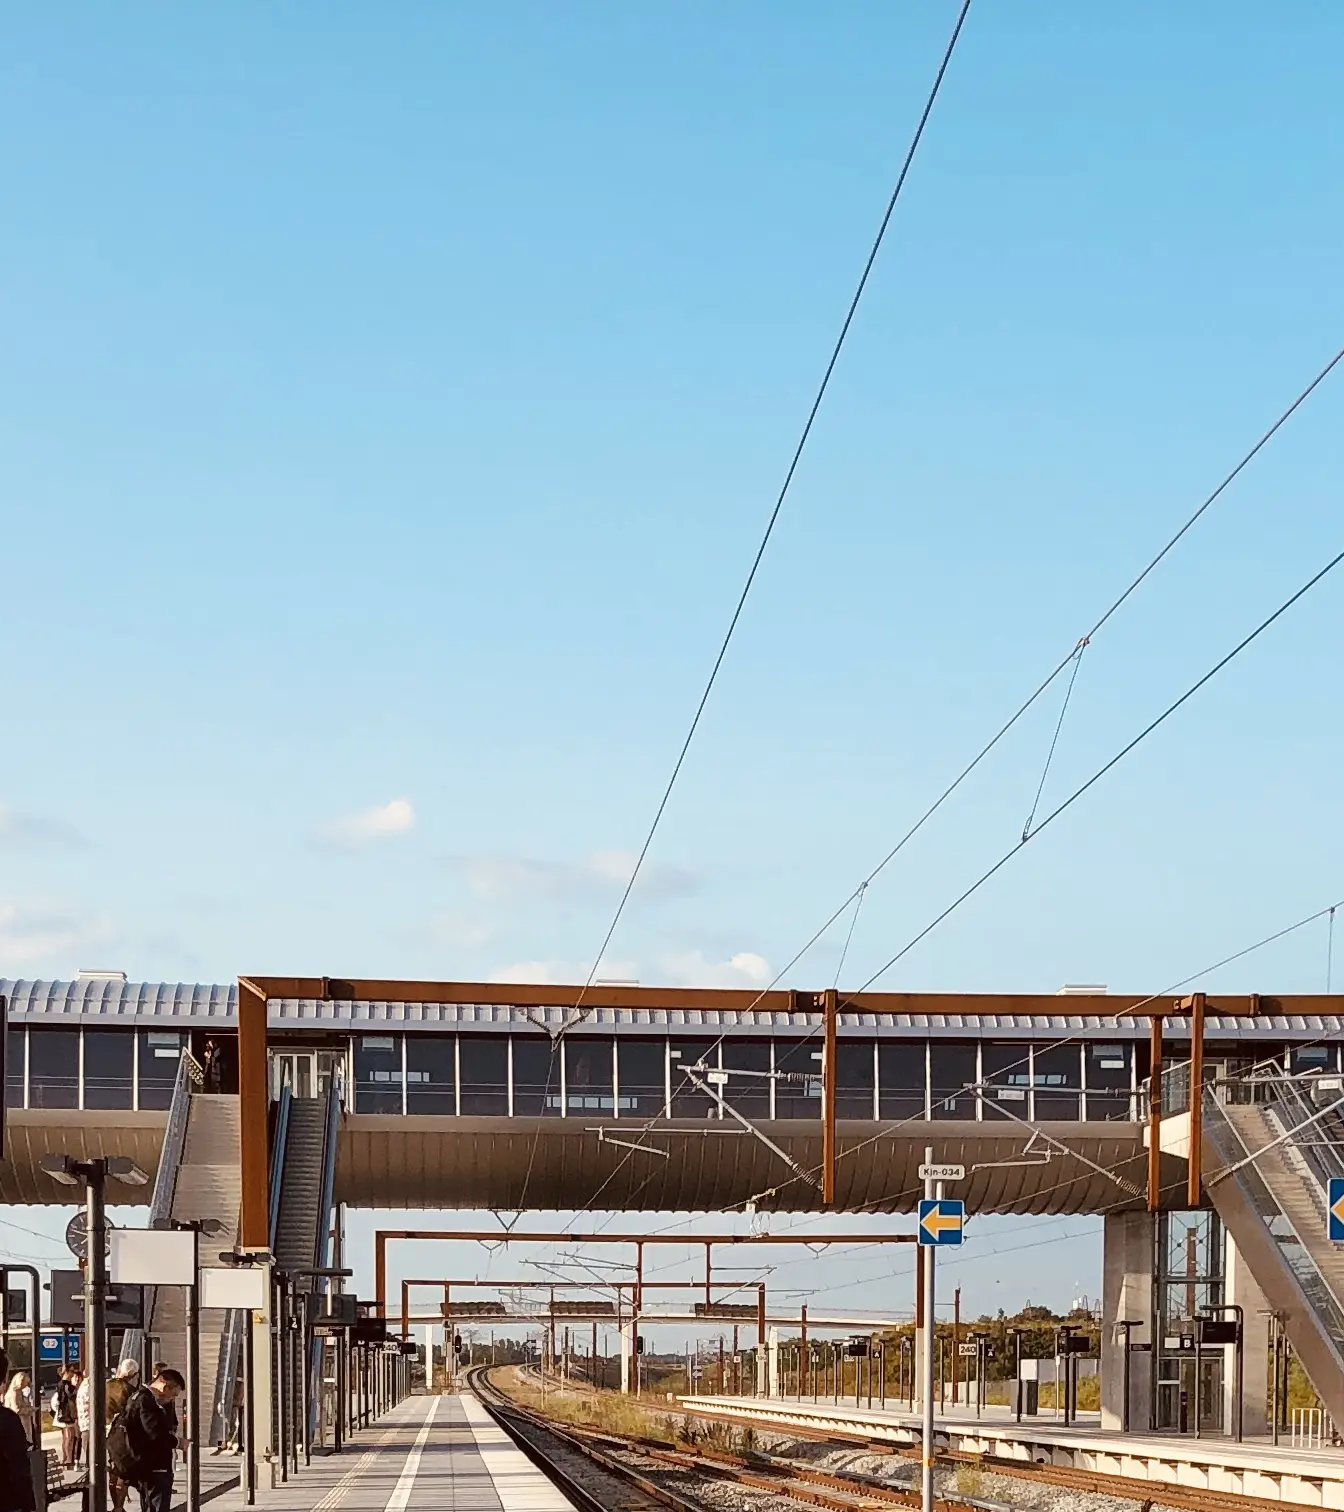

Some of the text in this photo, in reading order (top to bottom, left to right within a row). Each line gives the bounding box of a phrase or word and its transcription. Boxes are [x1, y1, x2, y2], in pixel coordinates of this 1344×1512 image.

[923, 1168, 960, 1176] Kjn-034
[1184, 1339, 1191, 1348] B
[960, 1345, 977, 1354] 240
